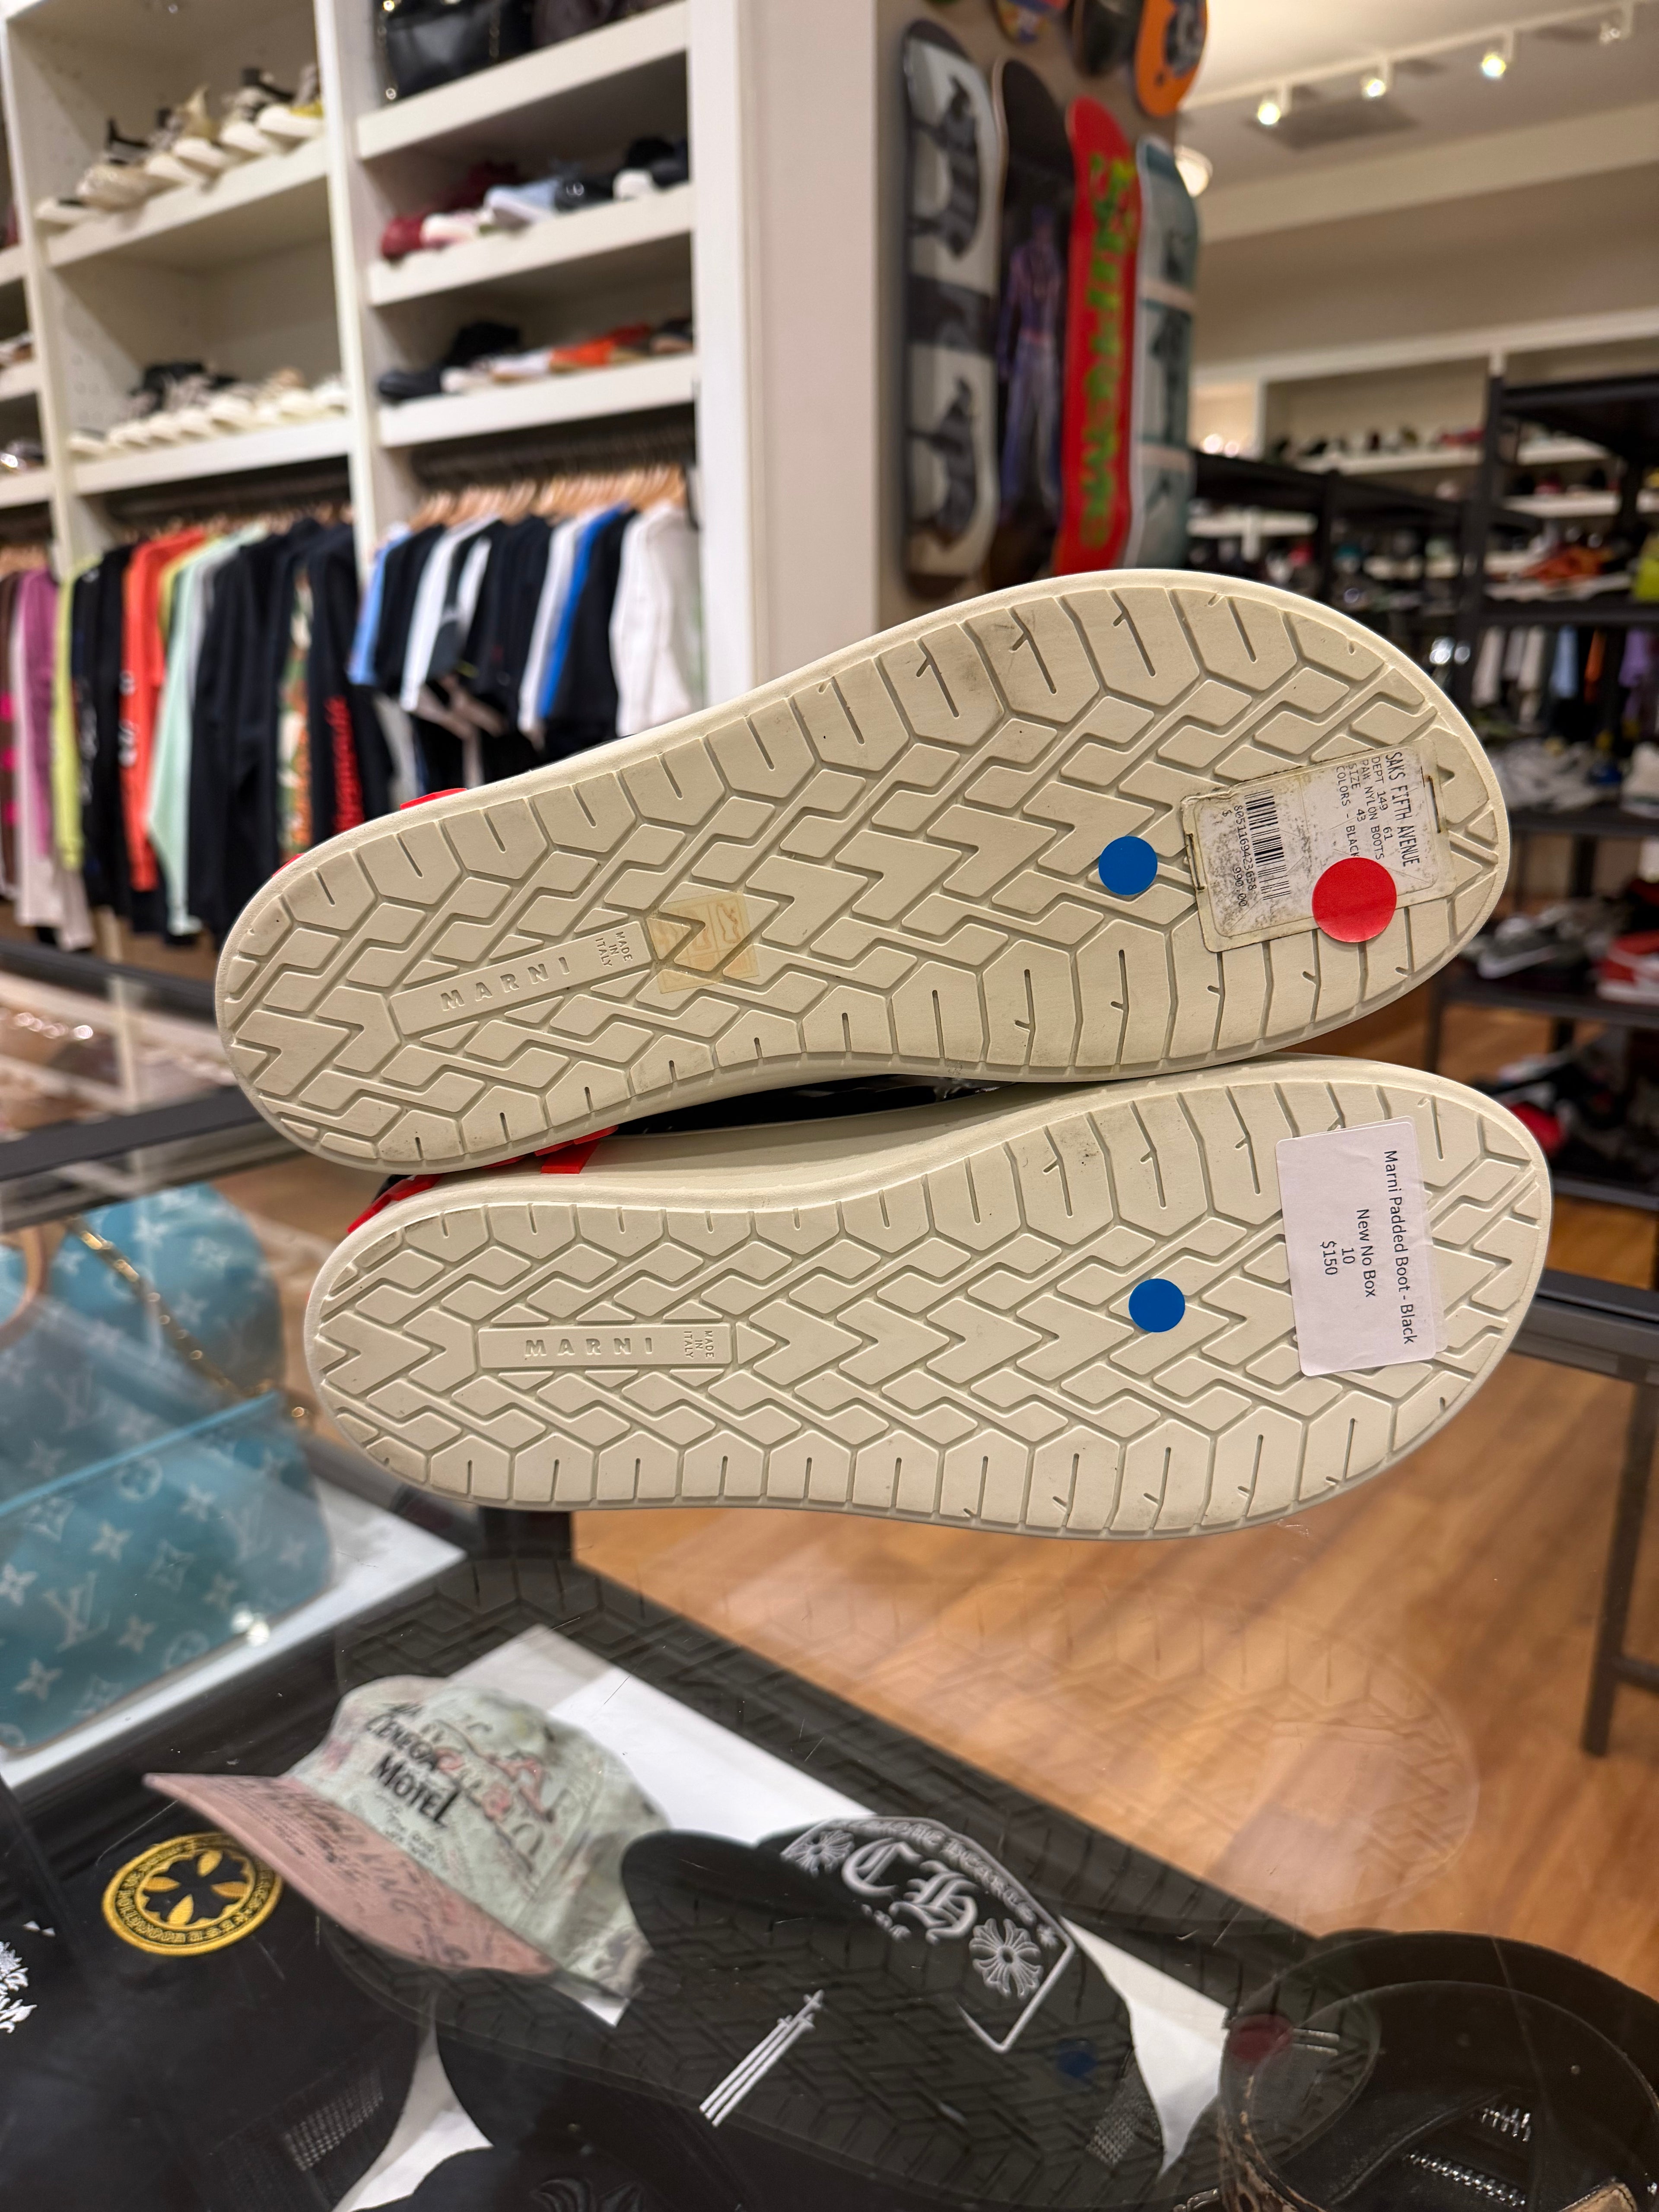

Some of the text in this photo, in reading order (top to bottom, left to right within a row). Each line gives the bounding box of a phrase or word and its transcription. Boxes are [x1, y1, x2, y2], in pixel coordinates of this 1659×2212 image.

[1348, 763, 1366, 822] SIZE 43
[1364, 786, 1378, 820] NYLON
[1371, 756, 1393, 841] DEPT 149 61
[1385, 751, 1420, 867] SAKS FIFTH AVENUE
[1336, 766, 1351, 806] COLORS
[1346, 825, 1360, 857] BLACK
[1234, 805, 1257, 890] 8051169423638
[1370, 825, 1384, 860] BOOTS
[1233, 867, 1247, 907] 990.00
[595, 938, 613, 966] ITALY
[609, 944, 620, 955] IN
[616, 931, 633, 962] MADE
[440, 955, 570, 1011] MARNI
[1384, 1150, 1402, 1192] Marni
[1389, 1195, 1408, 1253] Padded
[1319, 1240, 1338, 1276] $150
[1341, 1247, 1355, 1265] 10
[1356, 1208, 1376, 1297] New No Box
[1395, 1256, 1410, 1292] Boot
[1400, 1304, 1418, 1345] Black
[524, 1337, 653, 1357] MARNI
[684, 1331, 694, 1358] ITALY
[695, 1340, 703, 1349] IN
[705, 1331, 714, 1358] MADE
